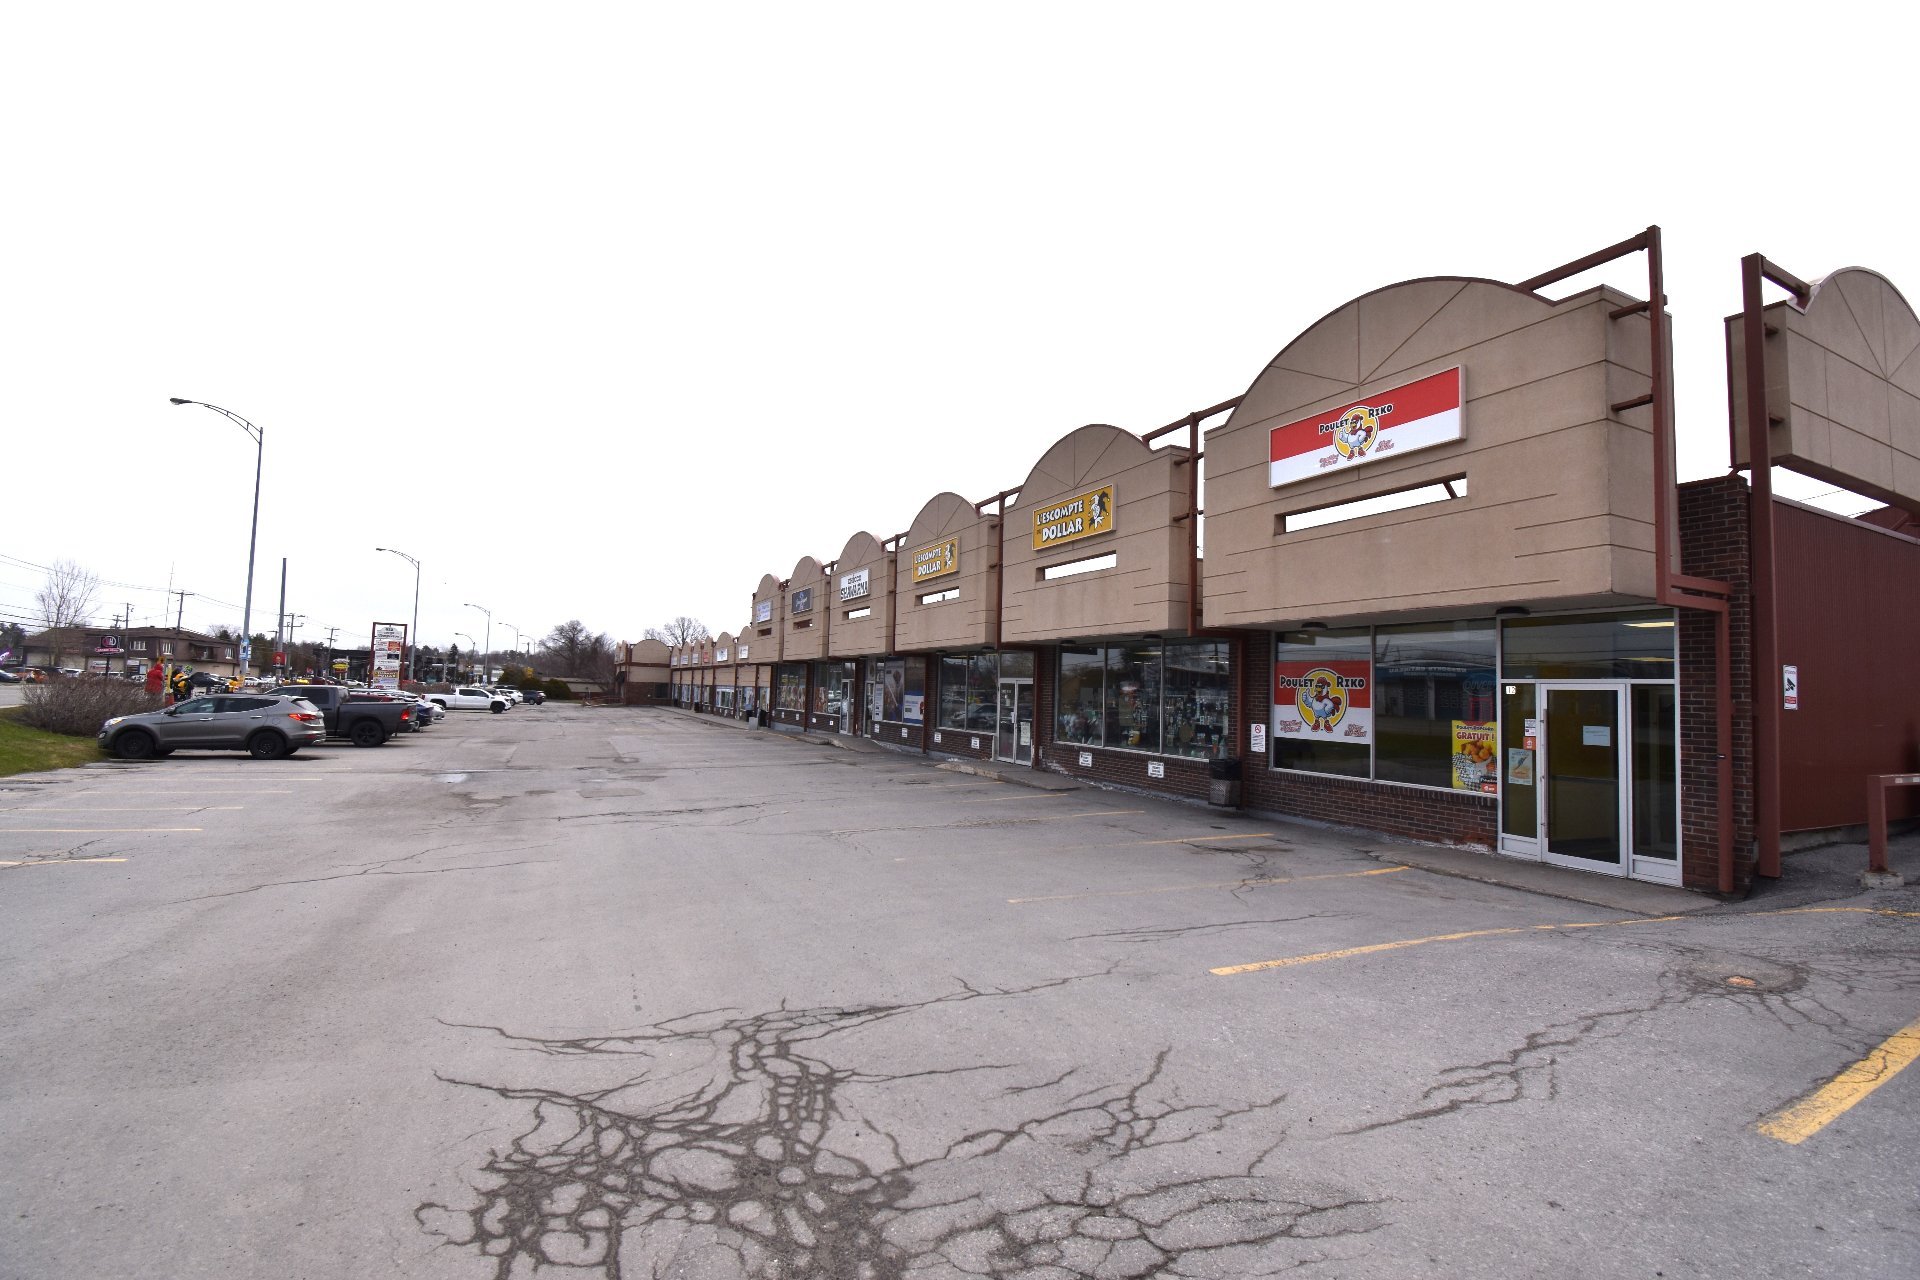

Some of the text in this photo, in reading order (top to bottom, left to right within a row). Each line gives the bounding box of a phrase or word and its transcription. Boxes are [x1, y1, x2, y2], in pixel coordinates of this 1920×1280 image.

[1320, 404, 1393, 434] POULET RIKO
[1036, 500, 1083, 525] L'ESCOMPTE
[1042, 518, 1083, 542] DOLLAR
[917, 560, 941, 577] DOLLAR
[1280, 675, 1365, 688] POULET RIKO
[1456, 732, 1490, 741] GRATUIT
